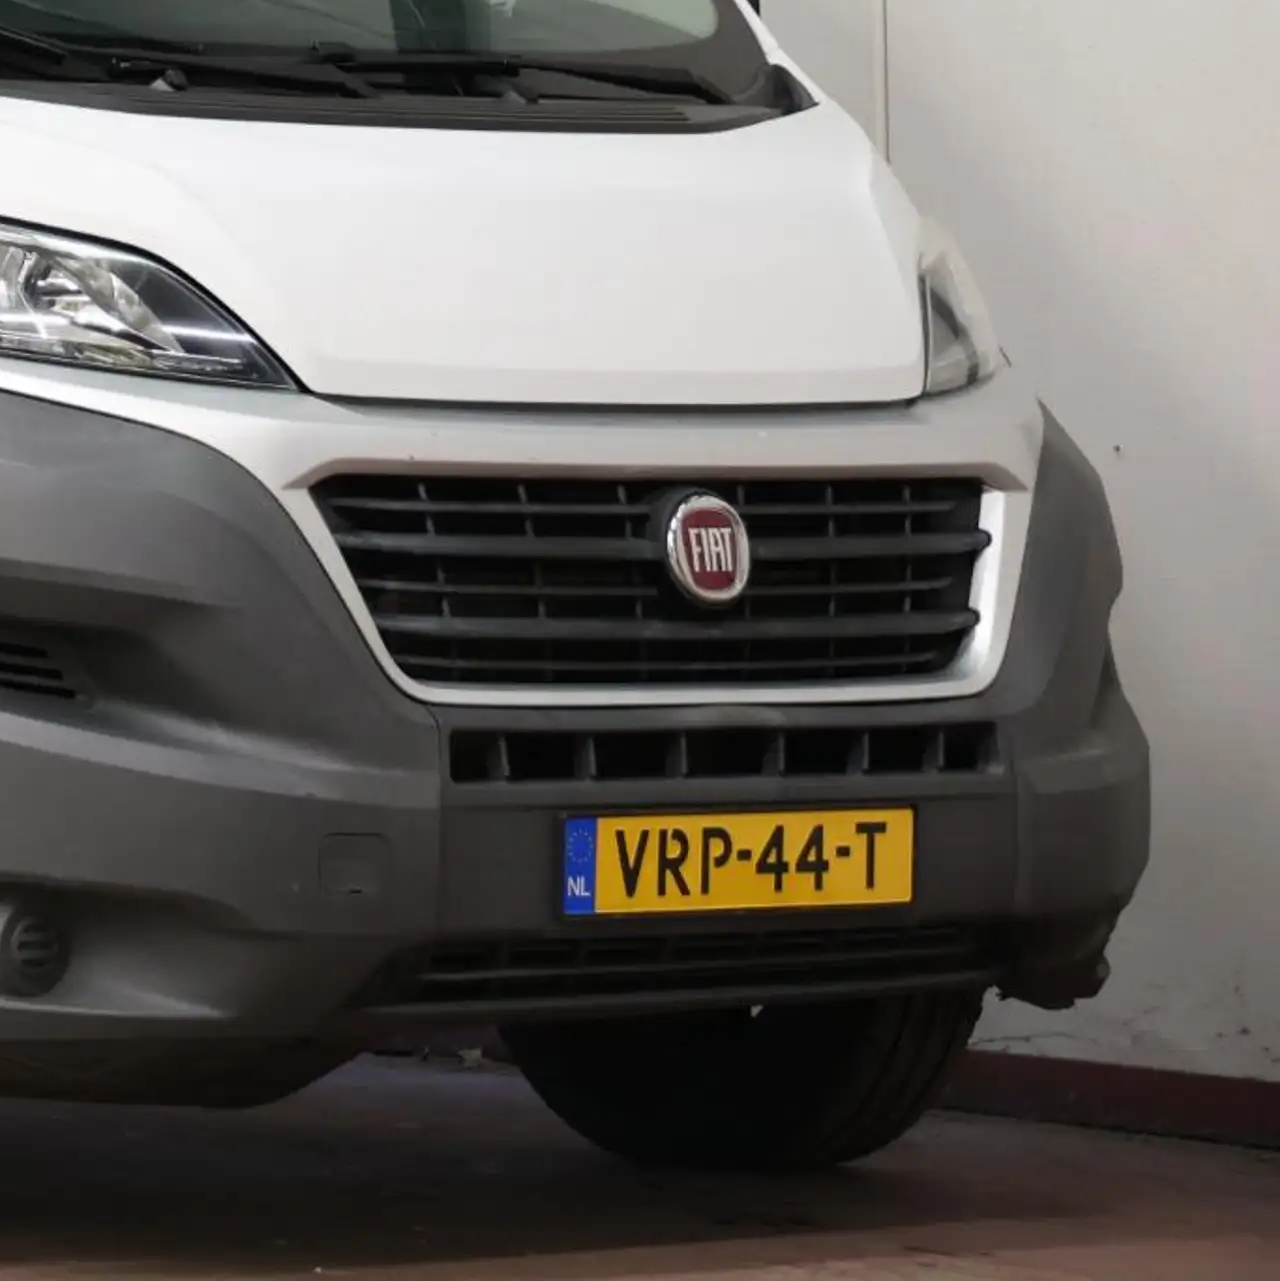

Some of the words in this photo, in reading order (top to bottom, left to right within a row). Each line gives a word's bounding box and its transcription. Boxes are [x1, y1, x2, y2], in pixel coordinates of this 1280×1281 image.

[688, 526, 734, 573] FIAT
[614, 821, 887, 898] VRP-44-T
[567, 876, 592, 897] NL
